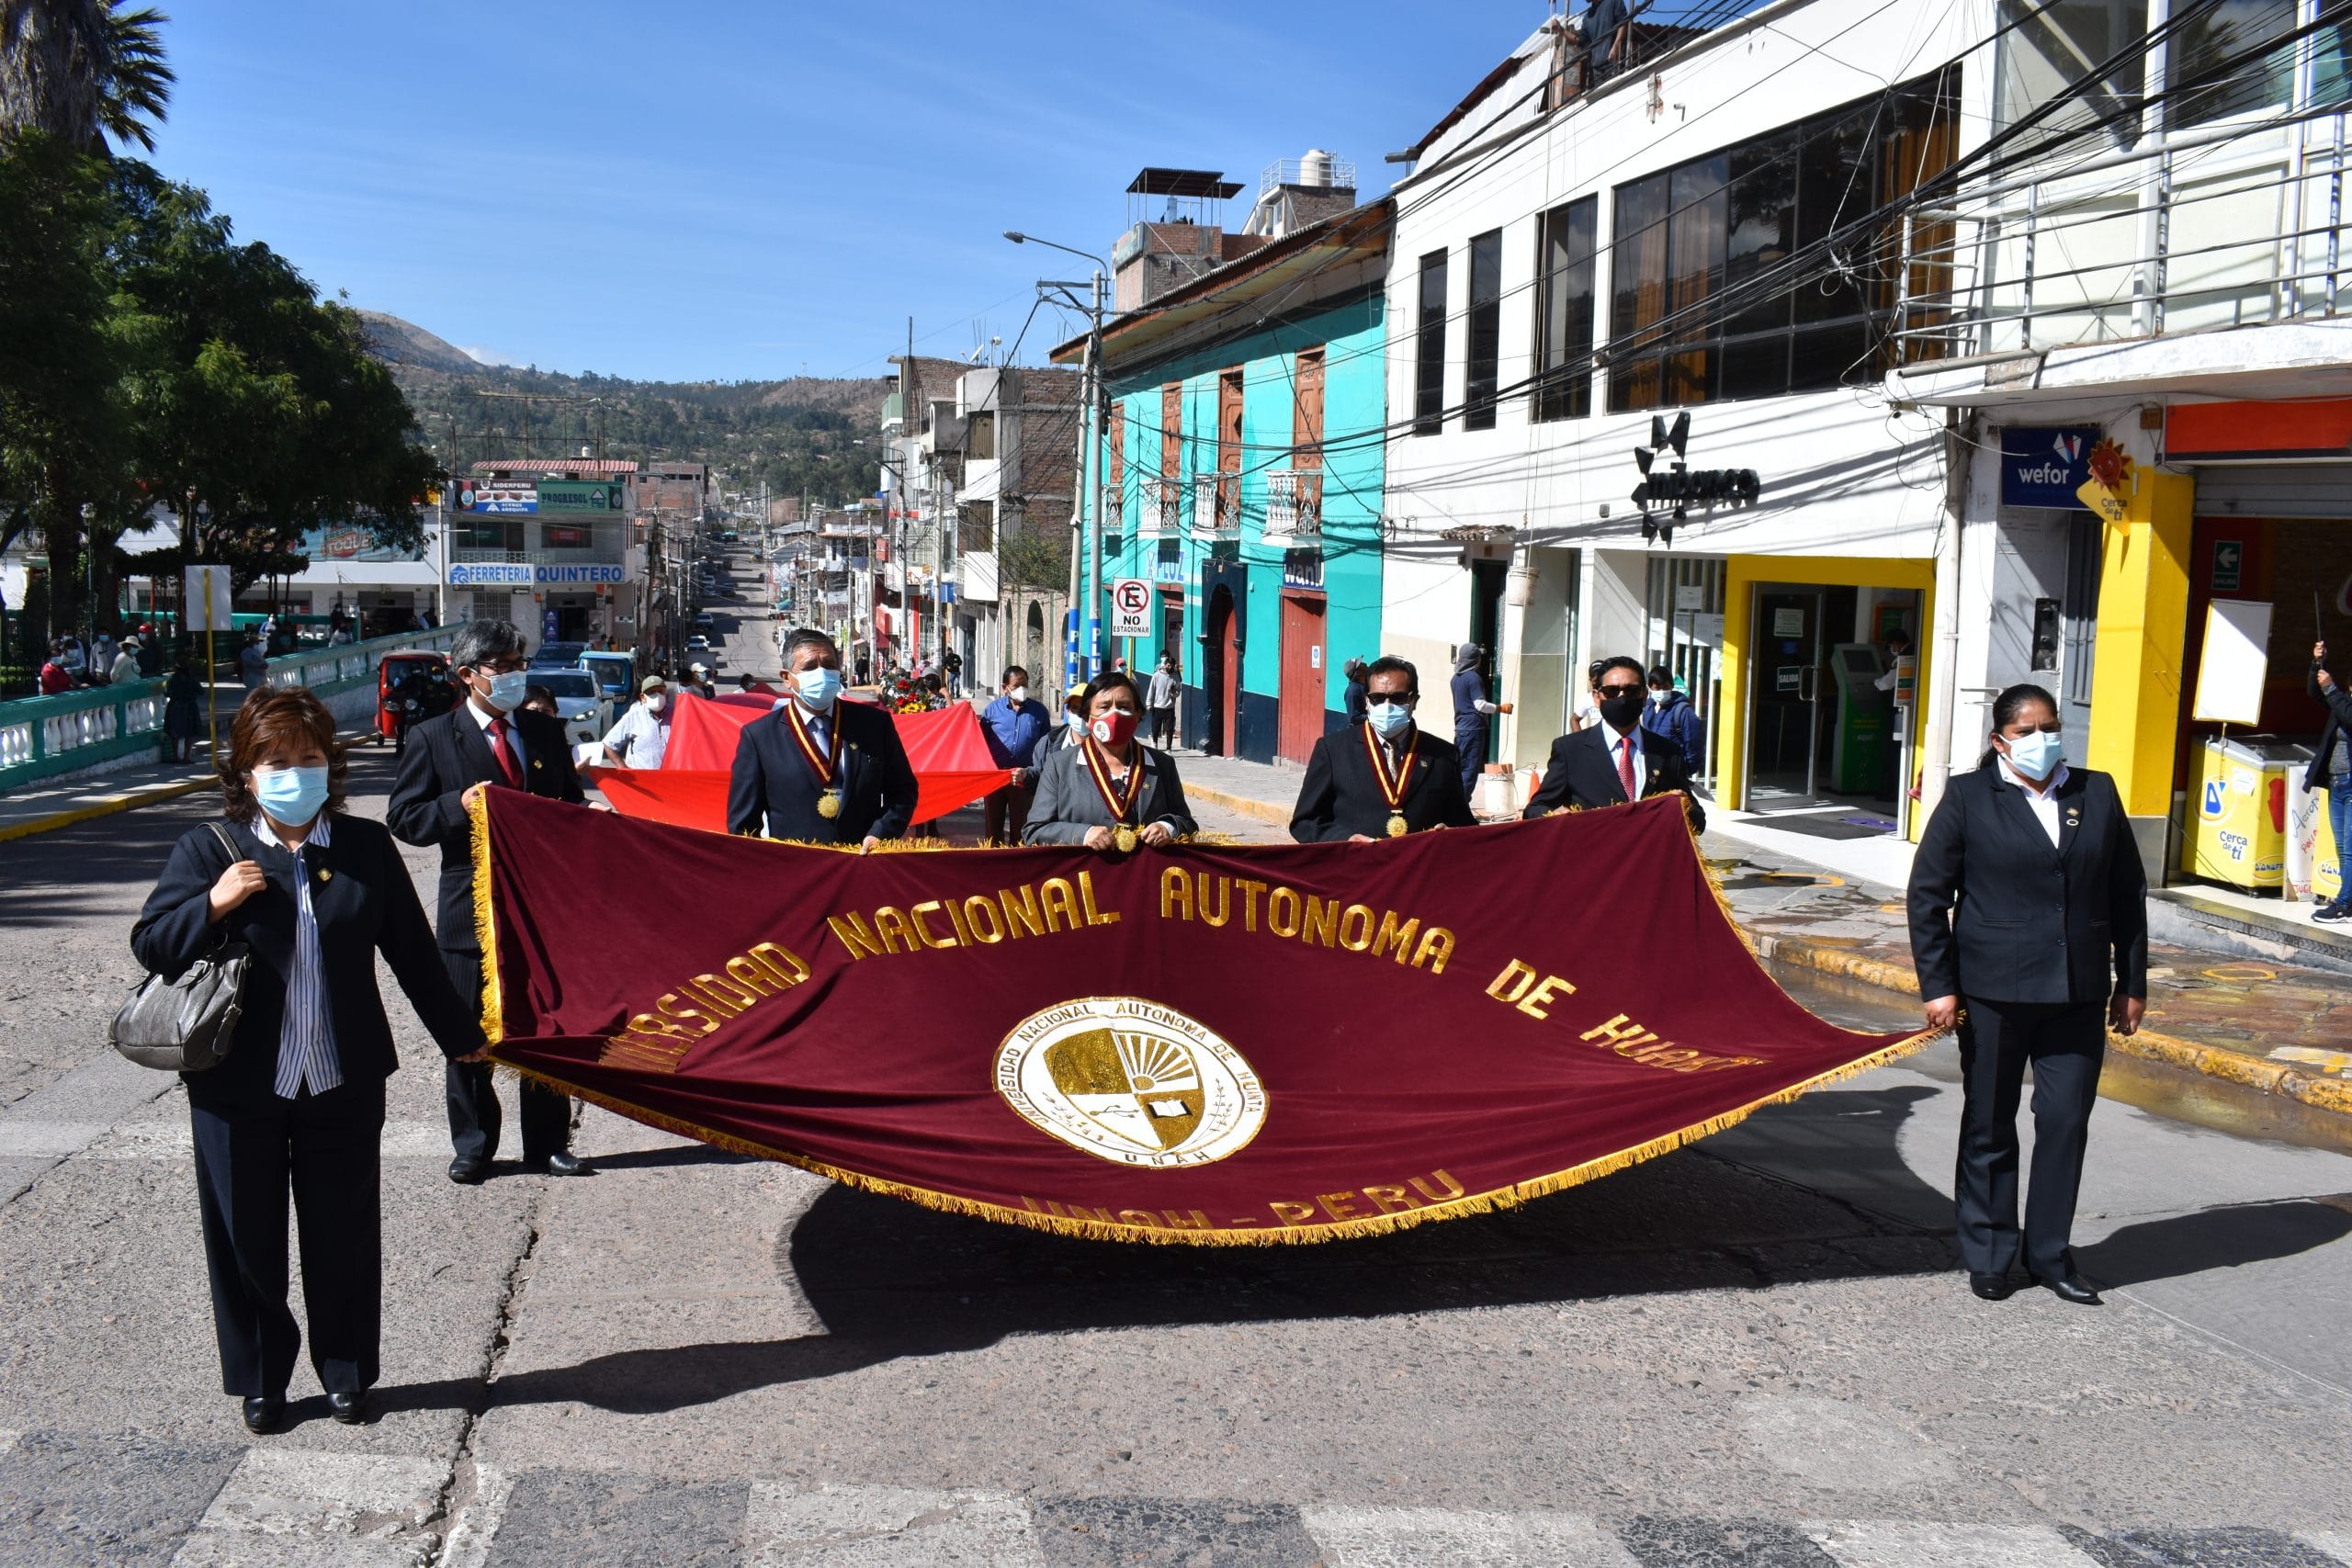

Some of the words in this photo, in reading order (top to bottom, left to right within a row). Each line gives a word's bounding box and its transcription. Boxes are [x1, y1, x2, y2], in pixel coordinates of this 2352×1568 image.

[2018, 461, 2070, 484] wefor
[541, 492, 588, 504] PROGRESOL
[2101, 498, 2128, 508] Cerca
[469, 566, 531, 581] FERRETERIA
[536, 567, 623, 582] QUINTERO
[1113, 626, 1149, 634] ESTACIONAR
[1123, 615, 1141, 626] NO
[1091, 627, 1102, 677] PLU
[1778, 674, 1799, 683] SALIDA
[2219, 830, 2248, 846] Cerca
[2222, 841, 2233, 851] de
[2232, 847, 2243, 861] ti
[827, 870, 1121, 960] NACIONAL
[1160, 865, 1455, 976] AUTONOMA
[1485, 958, 1577, 1020] DE
[1017, 1003, 1096, 1043] NACIONAL
[1115, 1001, 1206, 1041] AUTONOMA
[1212, 1042, 1238, 1062] DE
[1000, 1048, 1050, 1125] UNIVERSIDAD
[1125, 1152, 1210, 1166] UNAH
[1269, 1168, 1464, 1227] PERU
